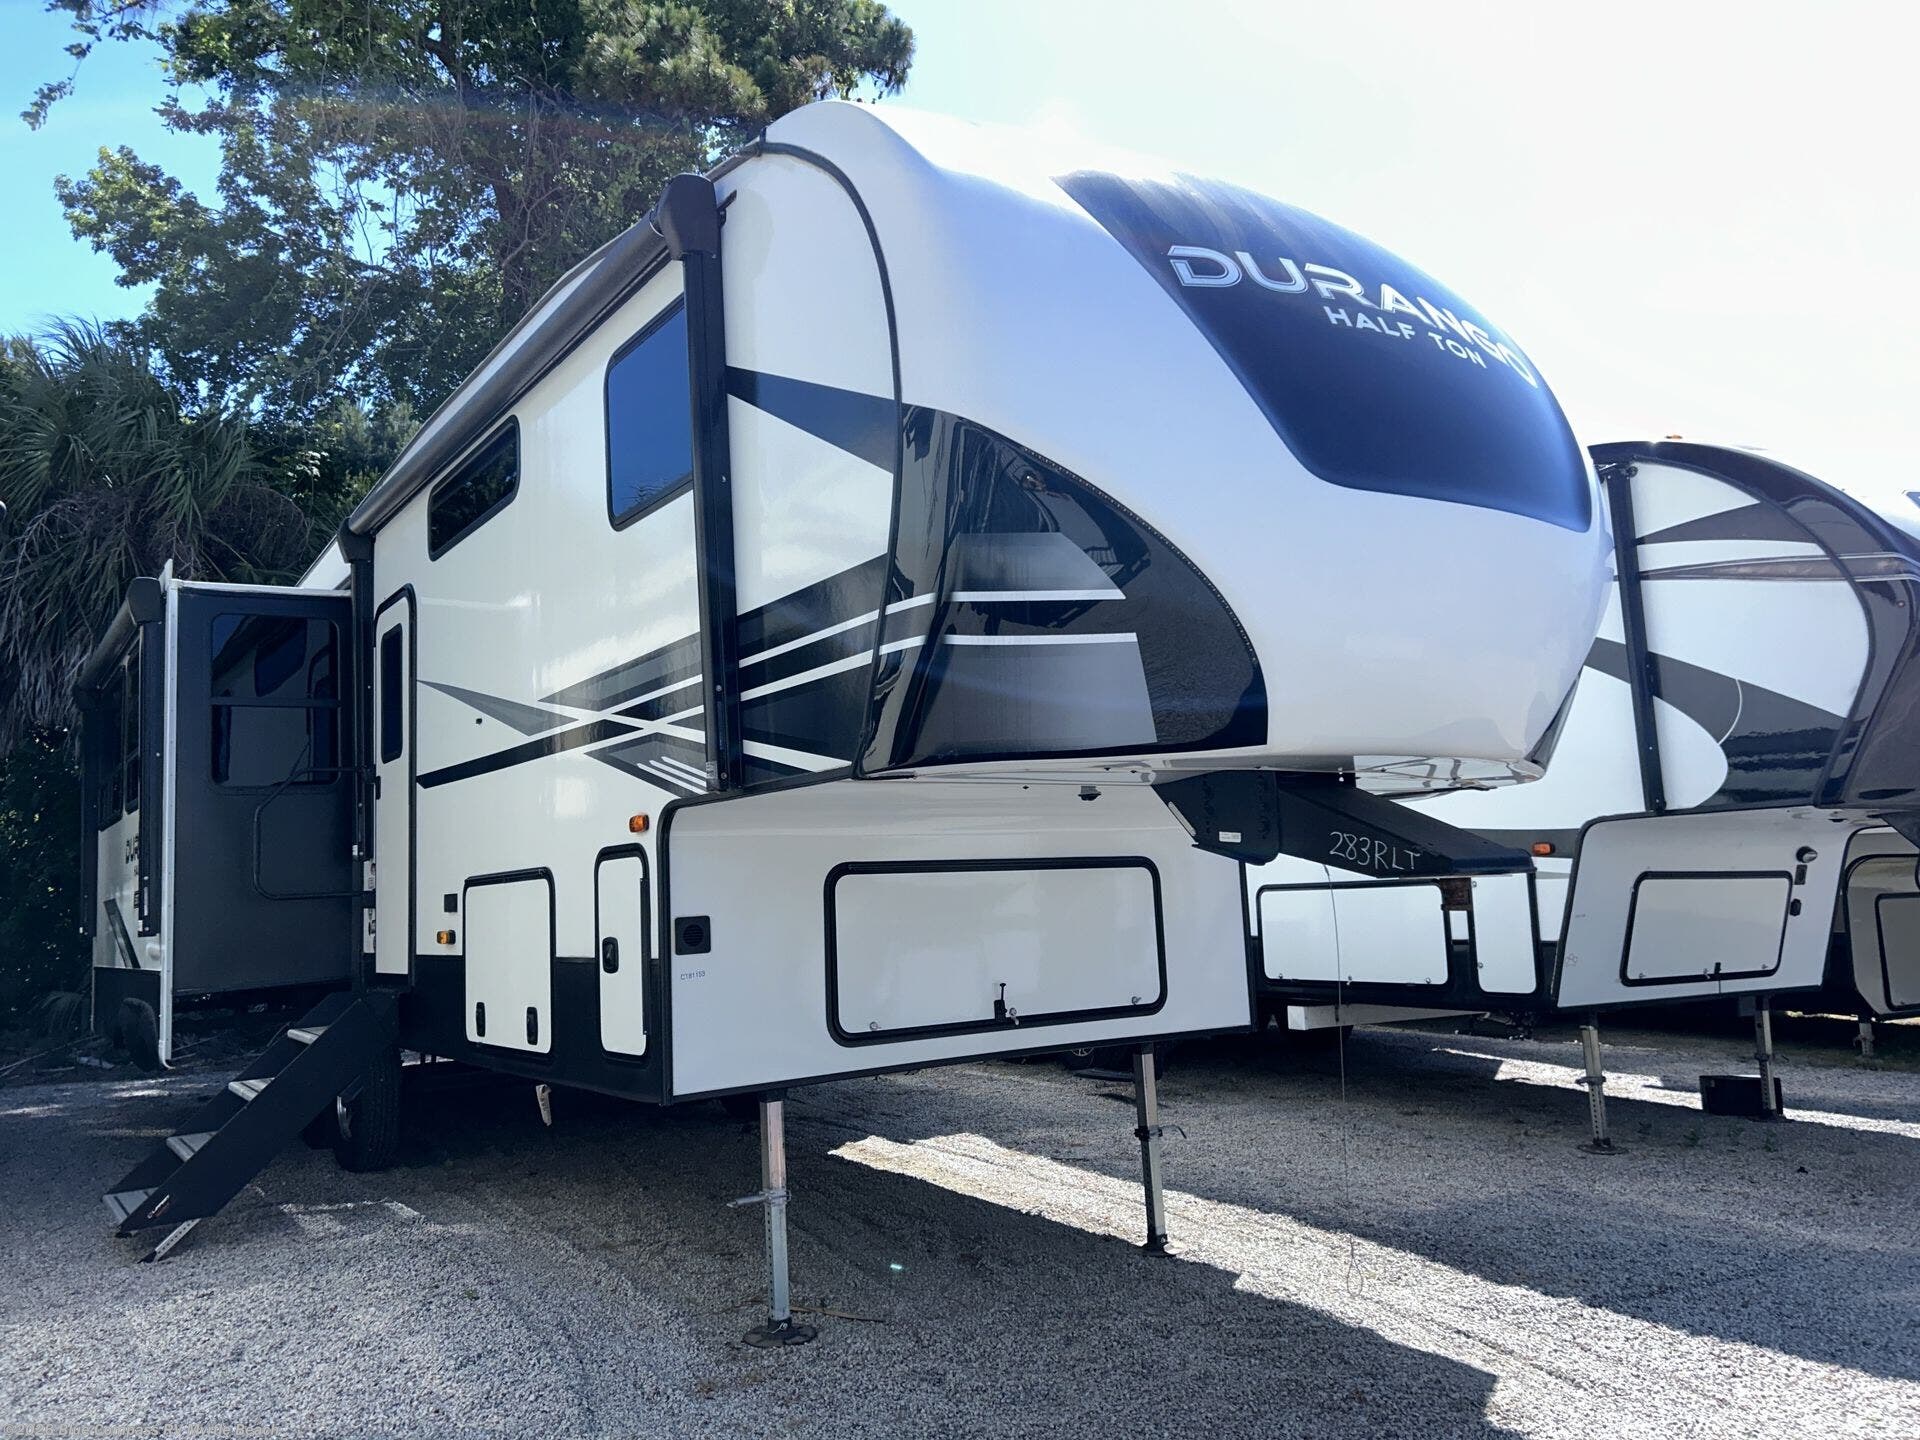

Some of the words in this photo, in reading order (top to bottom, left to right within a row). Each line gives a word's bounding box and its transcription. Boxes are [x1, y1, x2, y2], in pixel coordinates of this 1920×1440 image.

[1166, 244, 1538, 389] DURANGO
[1323, 305, 1416, 340] HALF
[1428, 331, 1487, 369] TON
[1328, 831, 1421, 871] 283RLT
